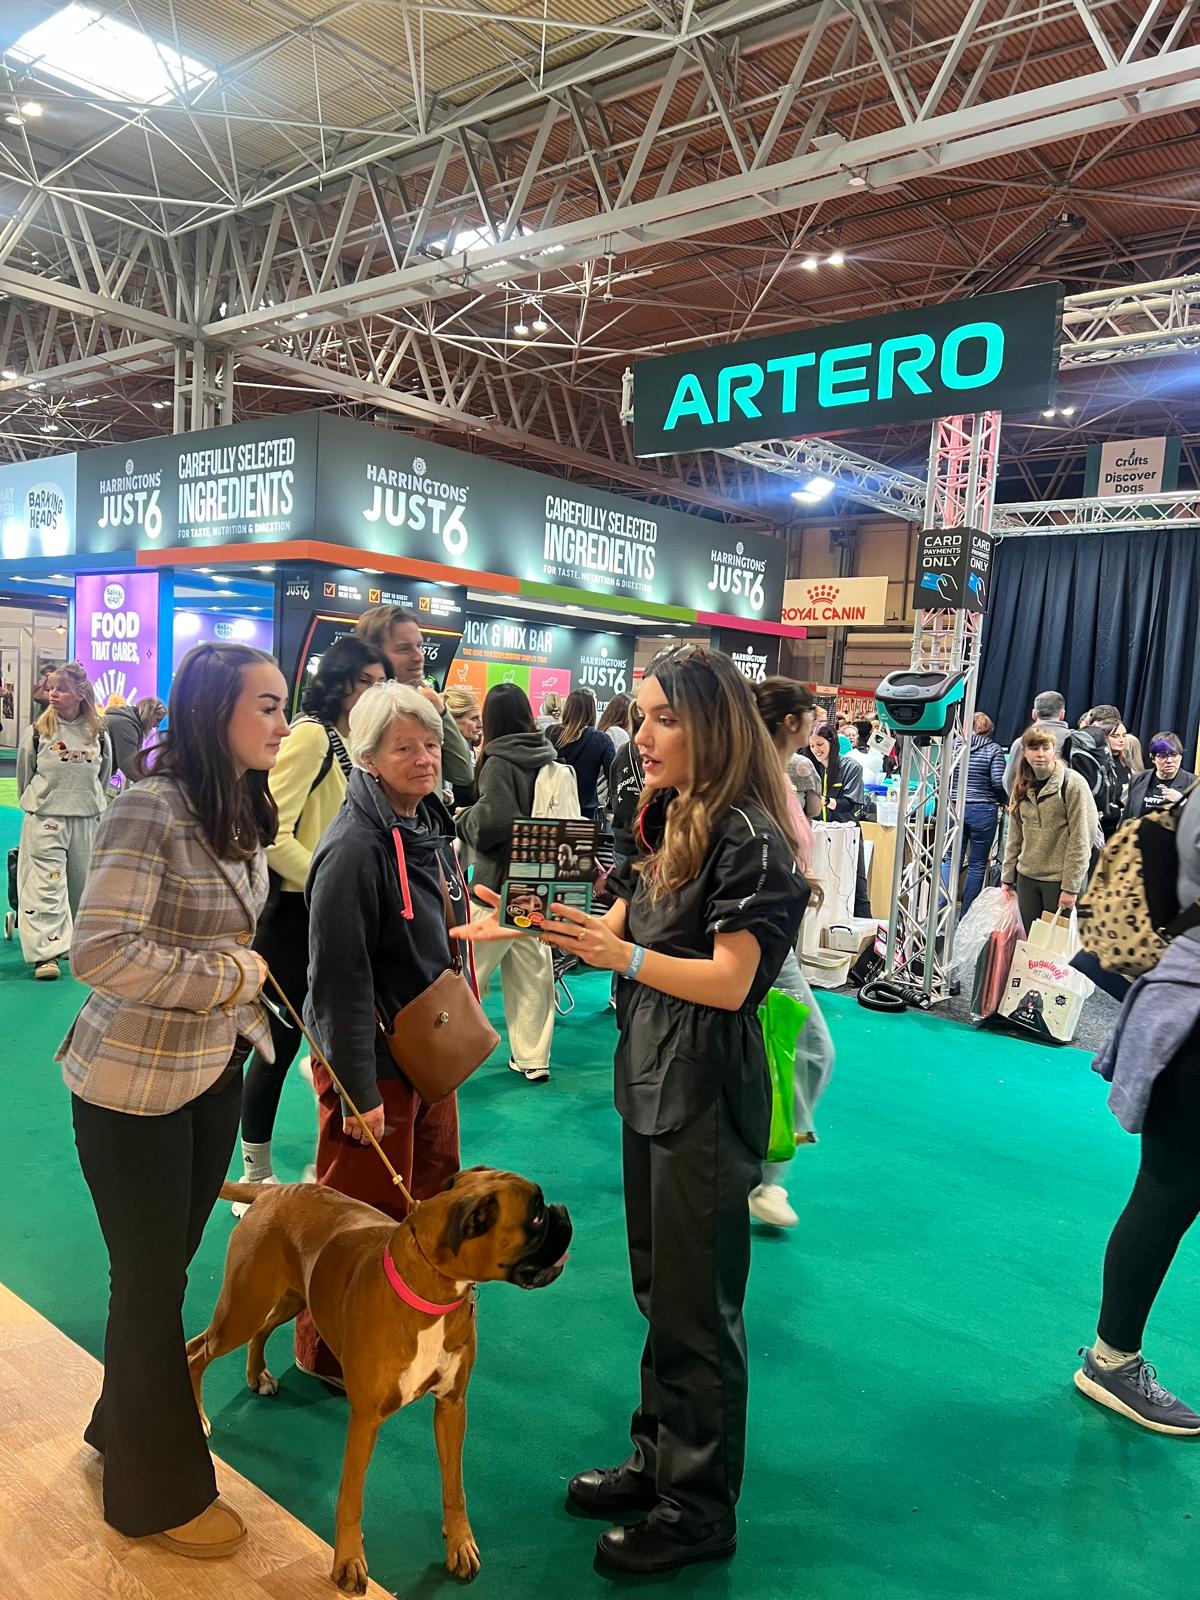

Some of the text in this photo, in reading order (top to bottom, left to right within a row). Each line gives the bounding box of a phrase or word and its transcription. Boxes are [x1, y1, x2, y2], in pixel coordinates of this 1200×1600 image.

[663, 321, 1005, 431] ARTERO
[178, 437, 296, 480] CAREFULLY SELECTED
[1115, 456, 1149, 468] Crufts
[99, 471, 162, 495] HARRINGTONS
[366, 463, 468, 504] HARRINGTONS
[1105, 471, 1157, 483] Discover
[178, 469, 294, 525] INGREDIENTS
[1115, 484, 1144, 494] Dogs
[28, 490, 63, 514] BARKING
[30, 509, 57, 530] HEADS
[178, 528, 190, 539] FOR
[247, 523, 254, 533] &
[254, 520, 291, 534] DIGESTION
[545, 494, 658, 545] CAREFULLY SELECTED
[543, 522, 656, 581] INGREDIENTS
[923, 547, 961, 555] PAYMENTS
[924, 535, 963, 547] CARD
[972, 536, 991, 552] CARD
[710, 550, 766, 573] HARRINGTONS
[922, 556, 960, 568] ONLY
[970, 557, 989, 573] ONLY
[543, 564, 652, 592] FOR TASTE, NUTRITION & DIGESTION
[91, 611, 140, 639] FOOD
[781, 606, 866, 621] ROYAL CANIN
[491, 624, 501, 647] &
[503, 626, 527, 650] MIX
[529, 630, 553, 653] BAR
[91, 640, 140, 664] THAT CARES,
[580, 655, 628, 669] HARRINGTONS
